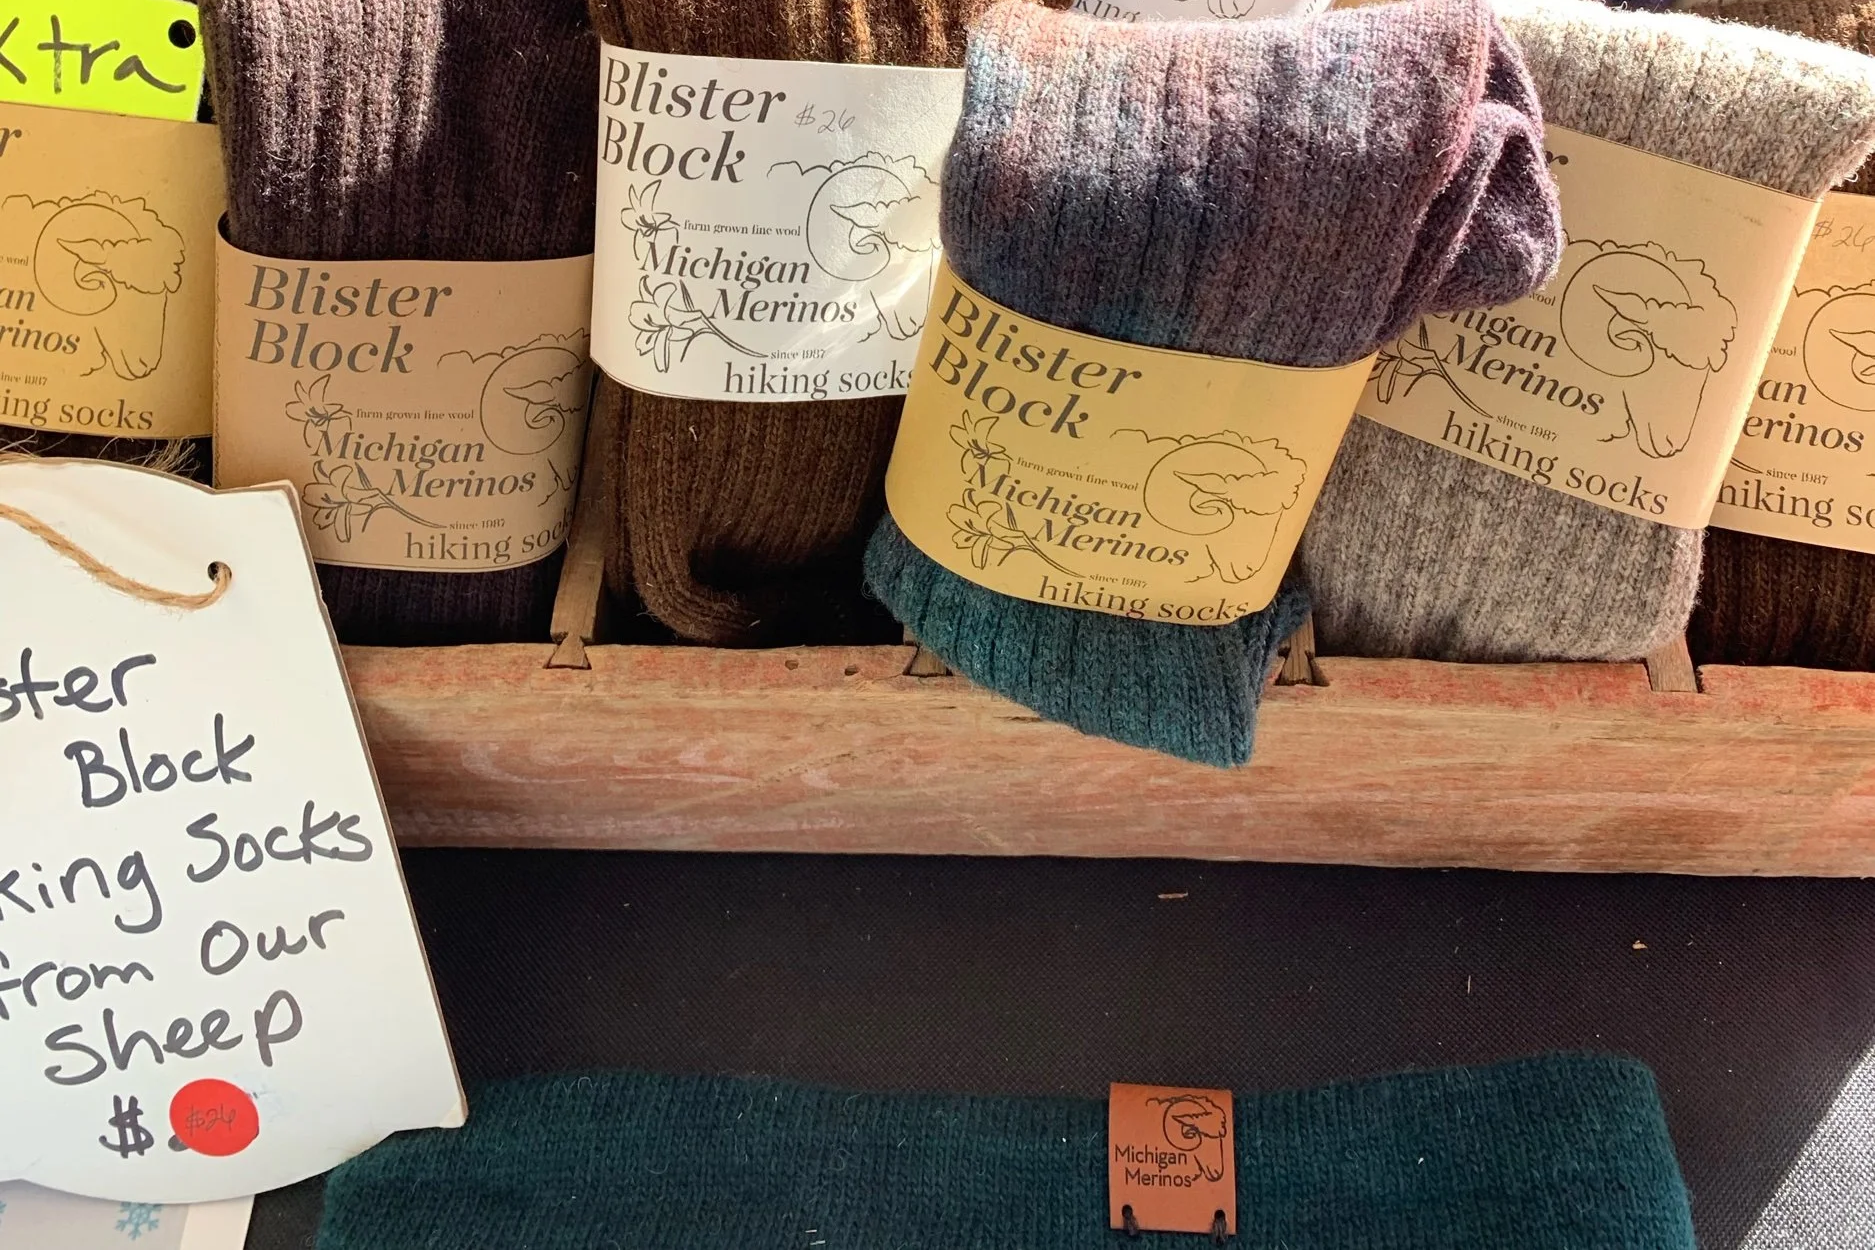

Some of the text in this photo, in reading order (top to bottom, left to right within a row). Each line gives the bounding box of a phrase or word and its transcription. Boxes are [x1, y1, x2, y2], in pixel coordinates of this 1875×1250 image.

[603, 57, 786, 124] Blister
[602, 115, 746, 183] Block
[713, 224, 748, 236] grown
[775, 225, 800, 236] wool
[638, 242, 811, 289] Michigan
[244, 264, 452, 318] Blister
[710, 288, 857, 323] Merinos
[246, 318, 414, 373] Block
[771, 350, 799, 359] since
[938, 286, 1142, 394] Blister
[723, 362, 830, 400] hiking
[928, 336, 1090, 439] Block
[1441, 334, 1604, 415] Merinos
[0, 389, 154, 430] ing socks
[386, 410, 421, 421] grown
[448, 409, 474, 419] wool
[1496, 414, 1527, 432] since
[310, 431, 485, 470] Michigan
[1743, 413, 1864, 452] erinos
[1046, 467, 1083, 482] grown
[1086, 473, 1108, 486] fine
[1111, 480, 1139, 492] wool
[1440, 410, 1668, 515] hiking socks
[1766, 468, 1797, 481] since
[386, 468, 536, 498] Merinos
[965, 463, 1142, 528] Michigan
[405, 507, 573, 564] hiking sock
[449, 520, 478, 530] since
[1032, 518, 1190, 566] Merinos
[1038, 575, 1249, 621] hiking socks
[1089, 573, 1118, 584] since
[64, 713, 255, 808] Block
[1115, 1144, 1187, 1169] Michigan
[1125, 1167, 1192, 1188] Merinos
